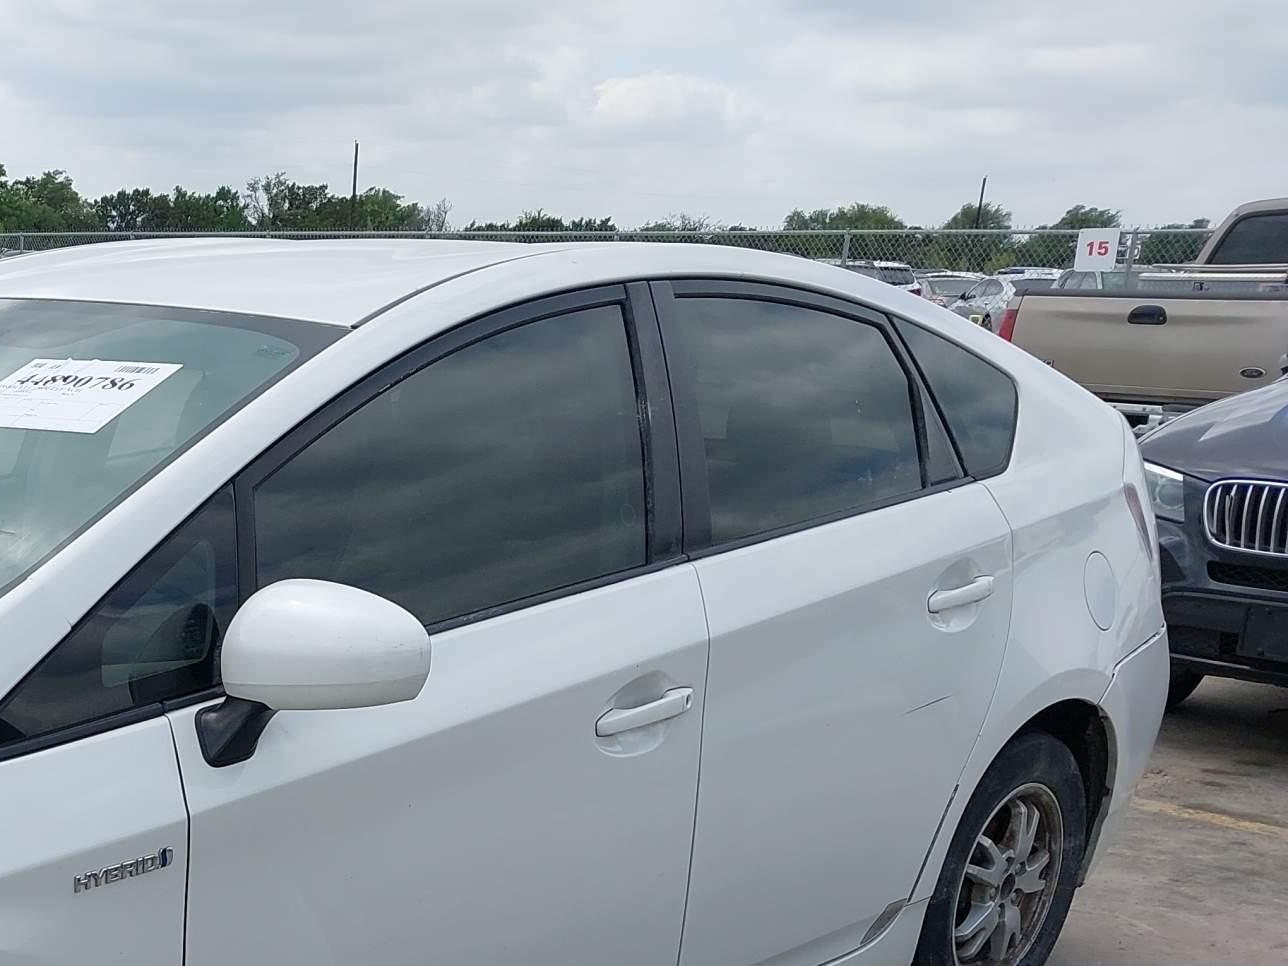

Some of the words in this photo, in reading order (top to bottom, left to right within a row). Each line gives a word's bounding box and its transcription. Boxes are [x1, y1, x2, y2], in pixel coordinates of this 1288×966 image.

[1086, 241, 1109, 256] 15
[16, 373, 141, 392] 44890786
[73, 854, 159, 894] HYBRID
